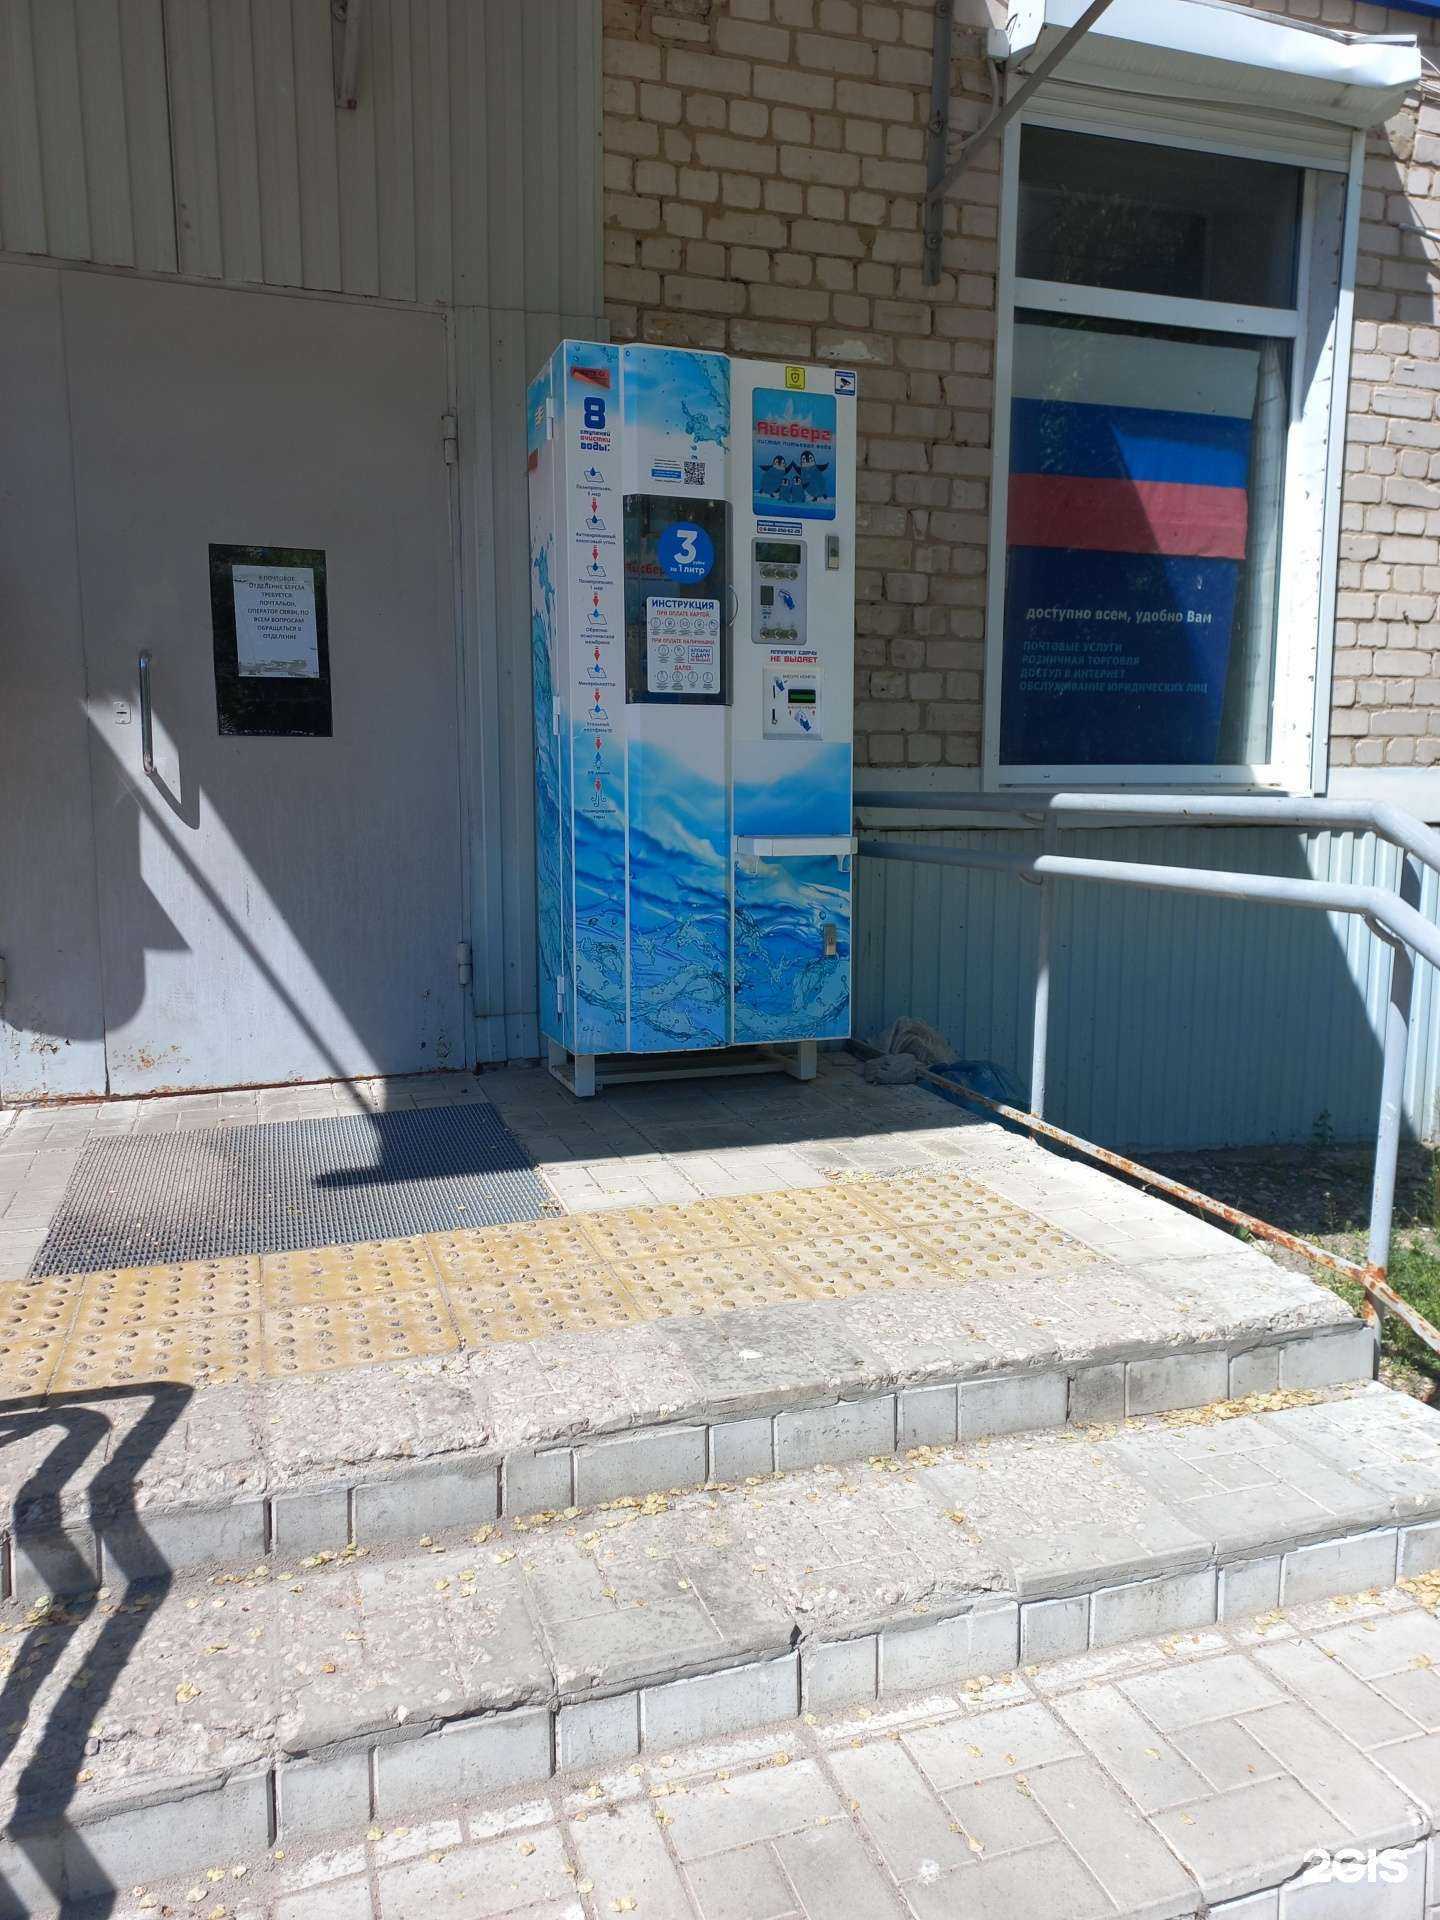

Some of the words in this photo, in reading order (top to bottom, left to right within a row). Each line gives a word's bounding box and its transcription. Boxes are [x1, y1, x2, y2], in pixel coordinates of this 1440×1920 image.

[584, 396, 606, 430] 8
[674, 529, 698, 565] 3
[651, 599, 715, 610] ИНСТРУКЦИЯ
[1026, 607, 1092, 623] доступно
[1095, 610, 1132, 624] всем,
[1135, 610, 1183, 625] удобно
[1186, 610, 1213, 623] Вам
[1020, 667, 1062, 680] ДОСТУП
